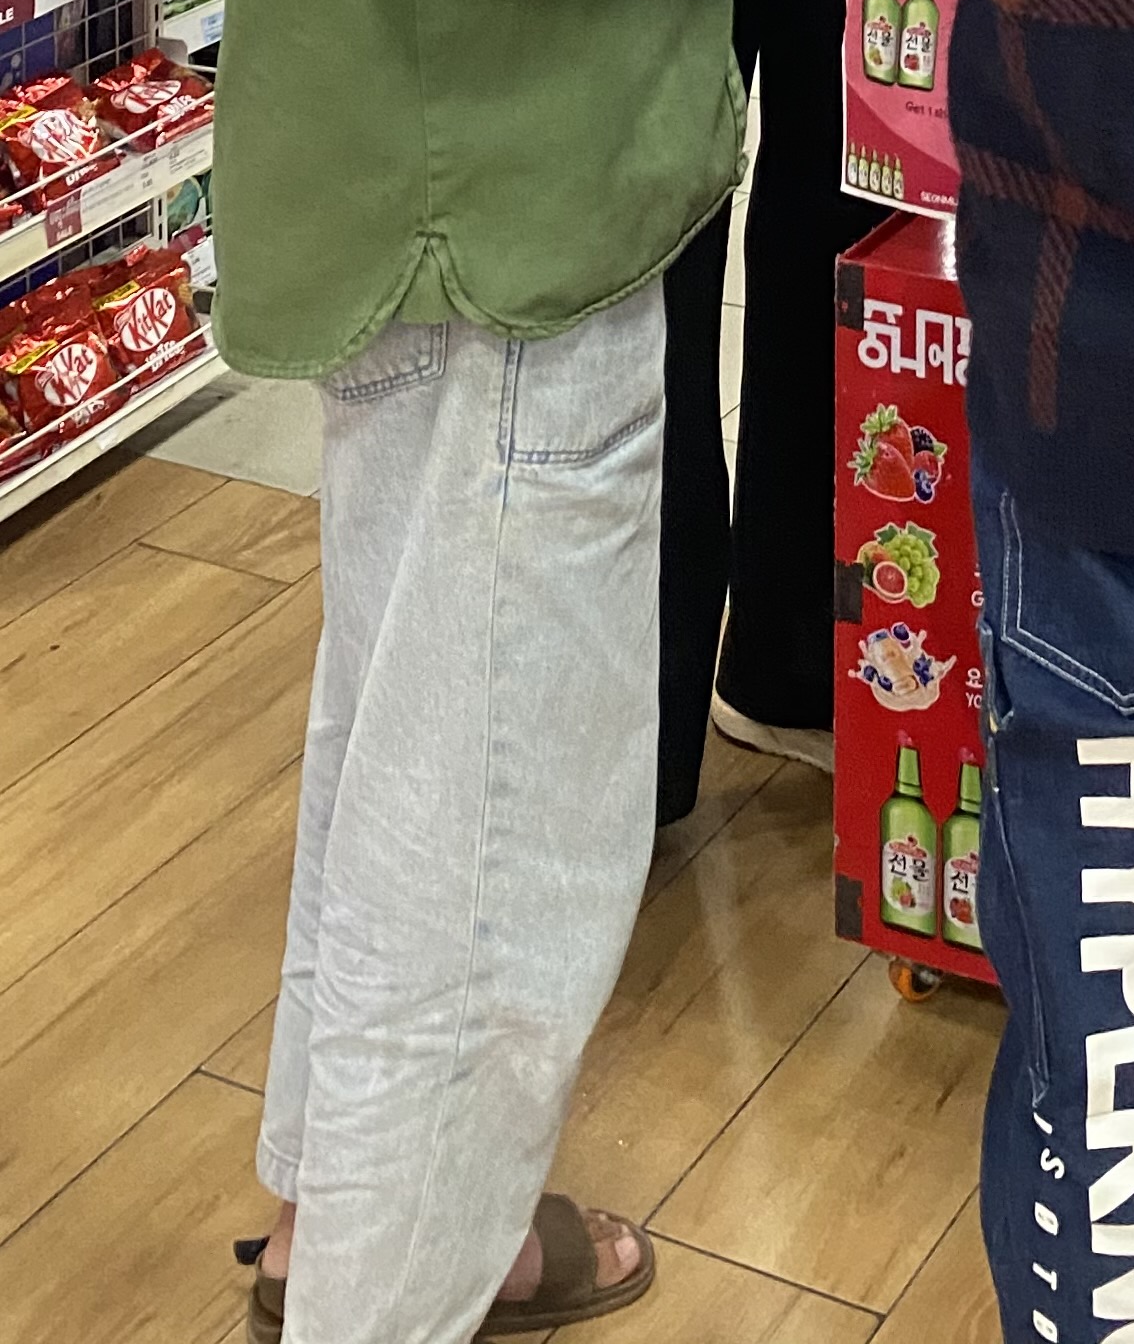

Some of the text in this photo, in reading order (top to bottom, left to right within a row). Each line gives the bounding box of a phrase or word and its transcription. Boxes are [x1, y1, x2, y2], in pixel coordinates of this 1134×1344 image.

[867, 30, 894, 48] 선물
[905, 35, 932, 53] 선물
[905, 101, 925, 116] Get
[126, 289, 174, 351] KitKat
[888, 853, 930, 883] 선물
[950, 870, 972, 896] 선
